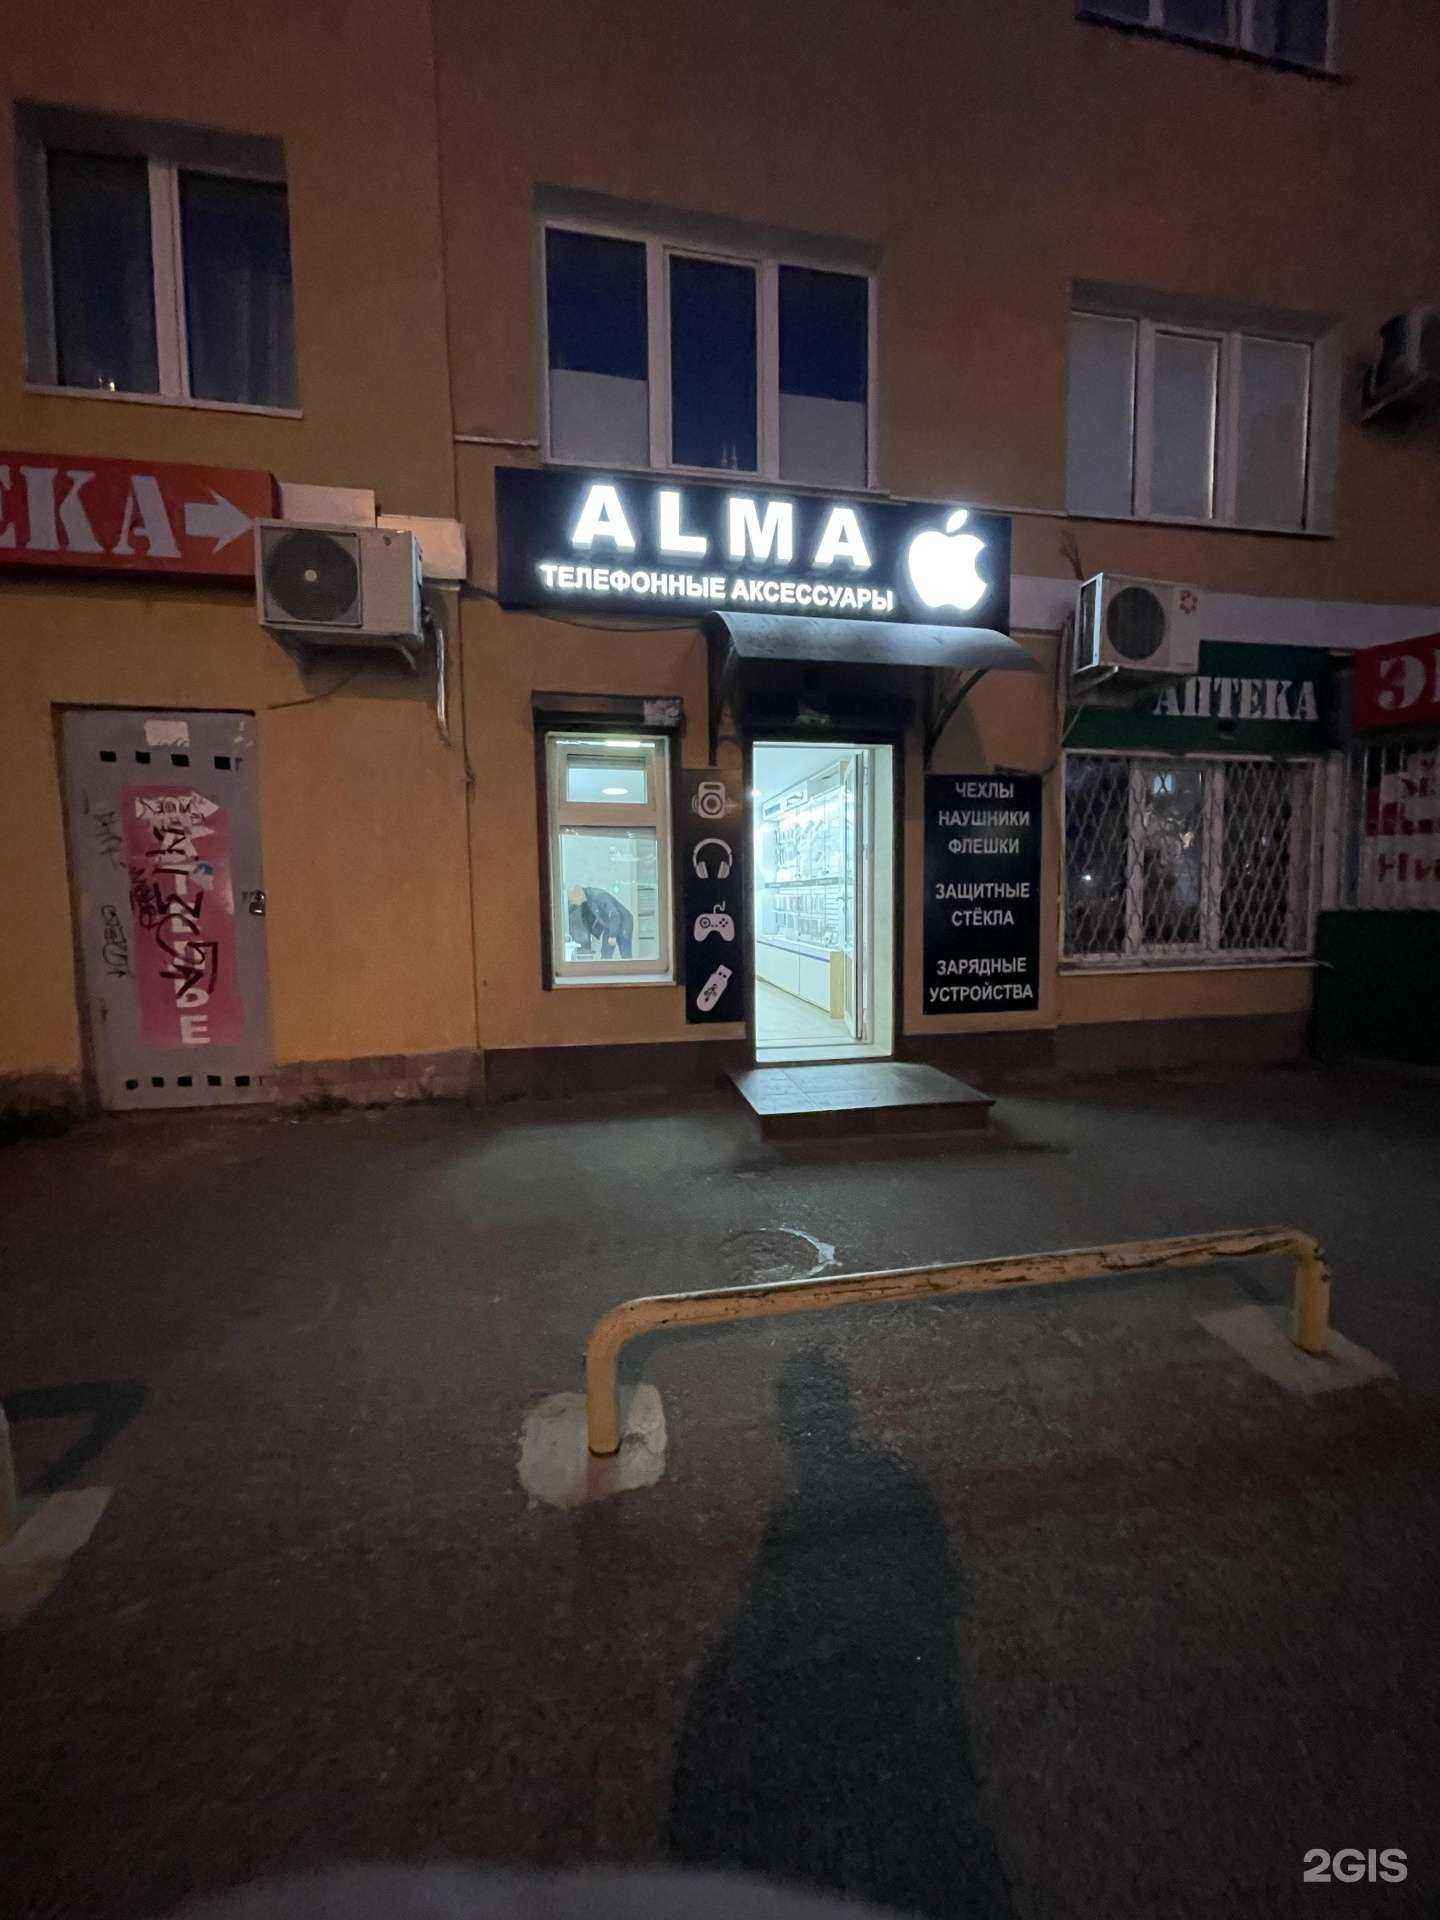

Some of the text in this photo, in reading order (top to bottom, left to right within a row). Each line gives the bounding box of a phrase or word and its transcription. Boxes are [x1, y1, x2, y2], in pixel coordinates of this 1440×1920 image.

[571, 483, 872, 571] ALMA
[540, 564, 894, 612] ТЕЛЕФОННЫЕ АКСЕССУАРЫ
[955, 781, 1014, 799] ЧЕХЛЫ
[938, 810, 1031, 827] НАУШНИКИ
[948, 838, 1020, 855] ФЛЕШКИ
[935, 882, 1031, 901] ЗАЩИТНЫЕ
[951, 907, 1015, 927] СТЁКЛА
[936, 957, 1027, 977] ЗАРЯДНЫЕ
[929, 980, 1034, 1003] УСТРОЙСТВА
